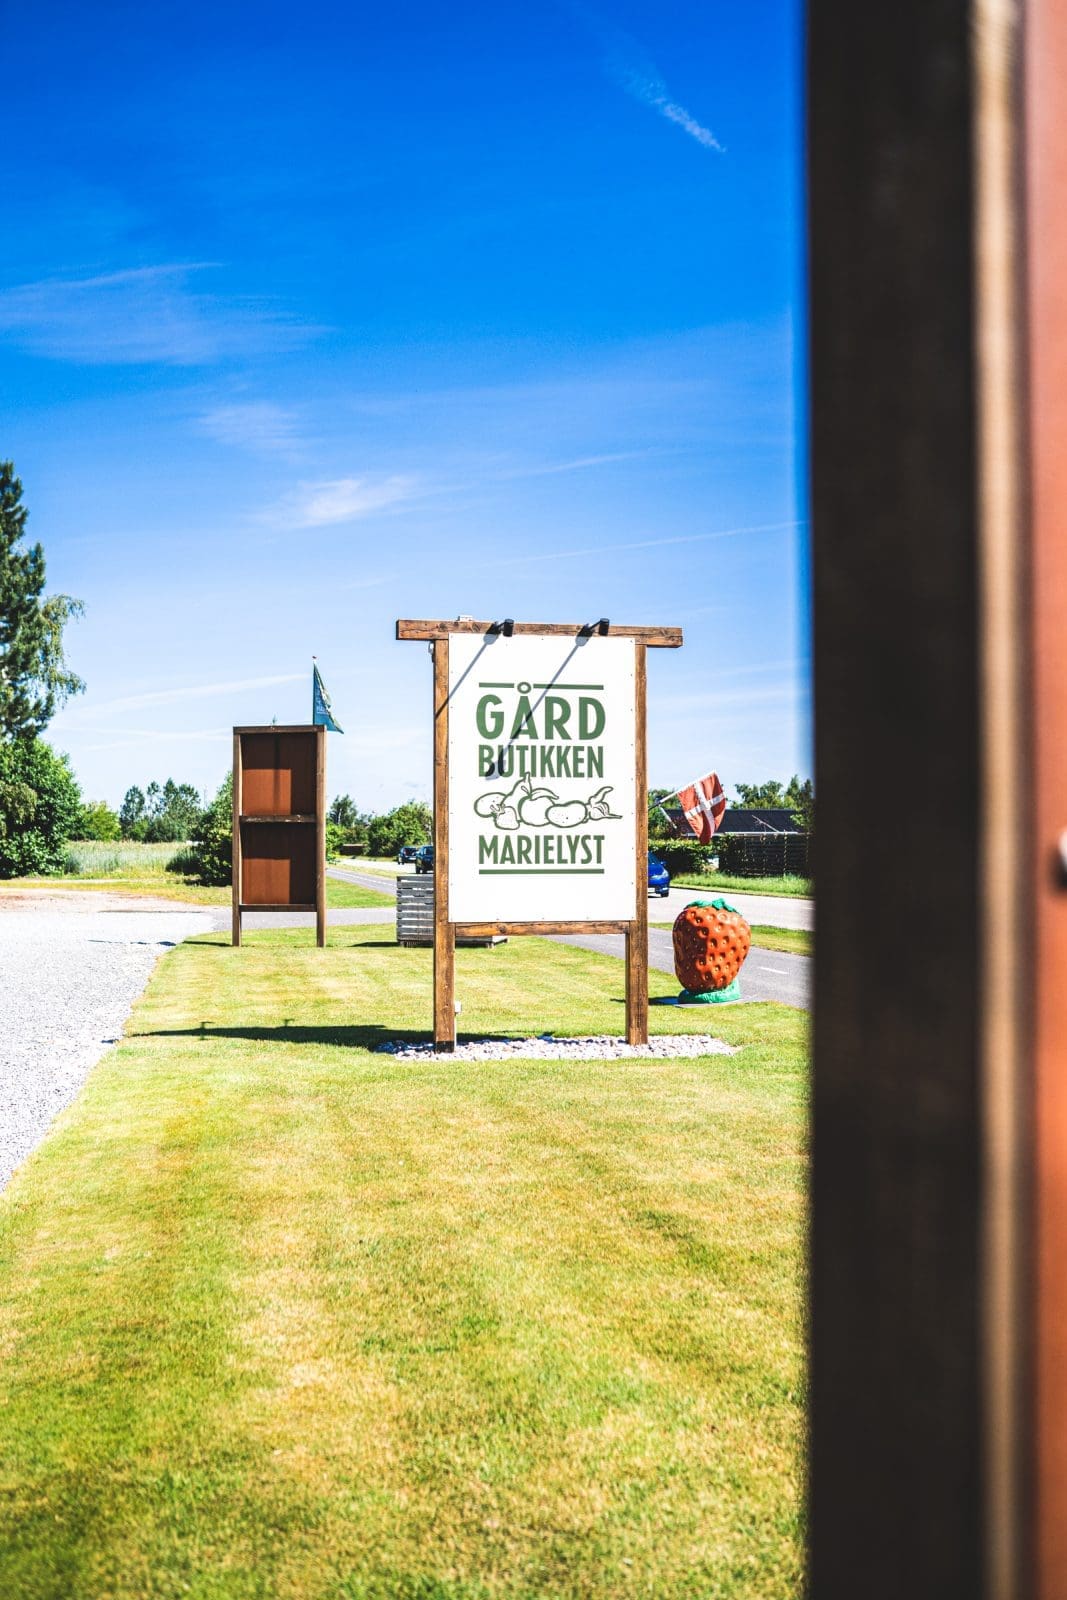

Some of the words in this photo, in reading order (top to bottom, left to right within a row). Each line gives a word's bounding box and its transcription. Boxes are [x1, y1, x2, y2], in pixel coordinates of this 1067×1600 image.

[476, 681, 606, 740] GÅRD
[478, 744, 604, 778] BUTIKKEN
[478, 835, 605, 865] MARIELYST
